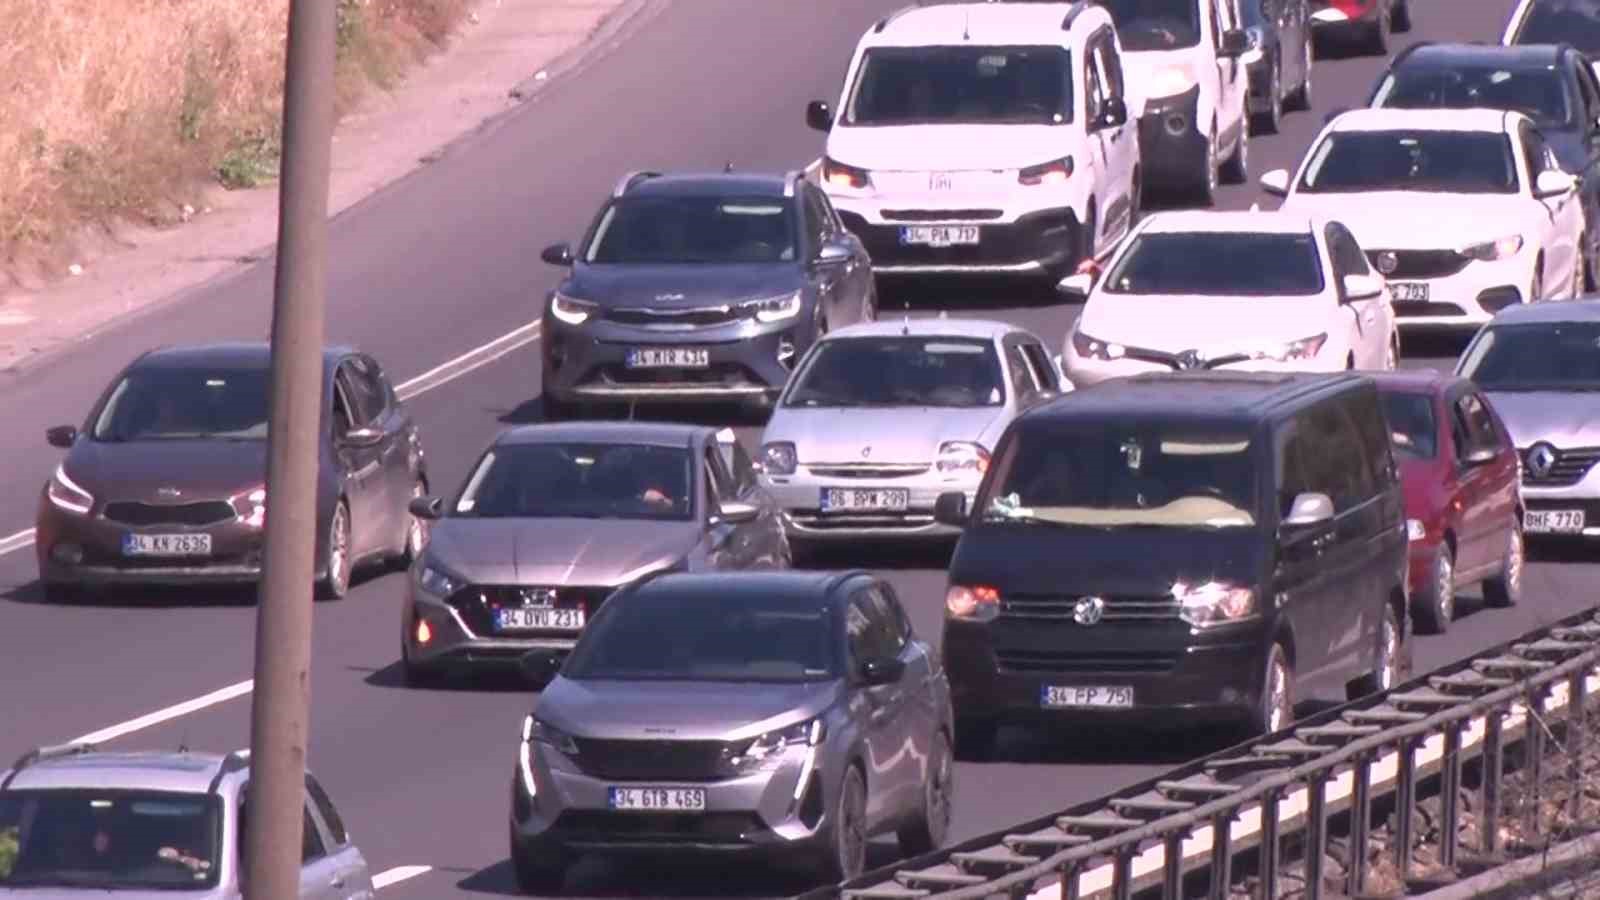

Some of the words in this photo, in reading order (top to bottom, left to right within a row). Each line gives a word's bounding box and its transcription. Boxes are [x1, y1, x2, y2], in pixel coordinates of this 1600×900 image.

[959, 227, 976, 241] 717
[882, 489, 905, 506] 299
[1555, 512, 1582, 527] 770
[128, 535, 144, 551] 34
[175, 535, 208, 551] 2636
[503, 609, 518, 626] 34
[555, 609, 579, 626] 231
[1048, 687, 1067, 704] 34
[617, 790, 634, 806] 34
[674, 790, 702, 807] 469
